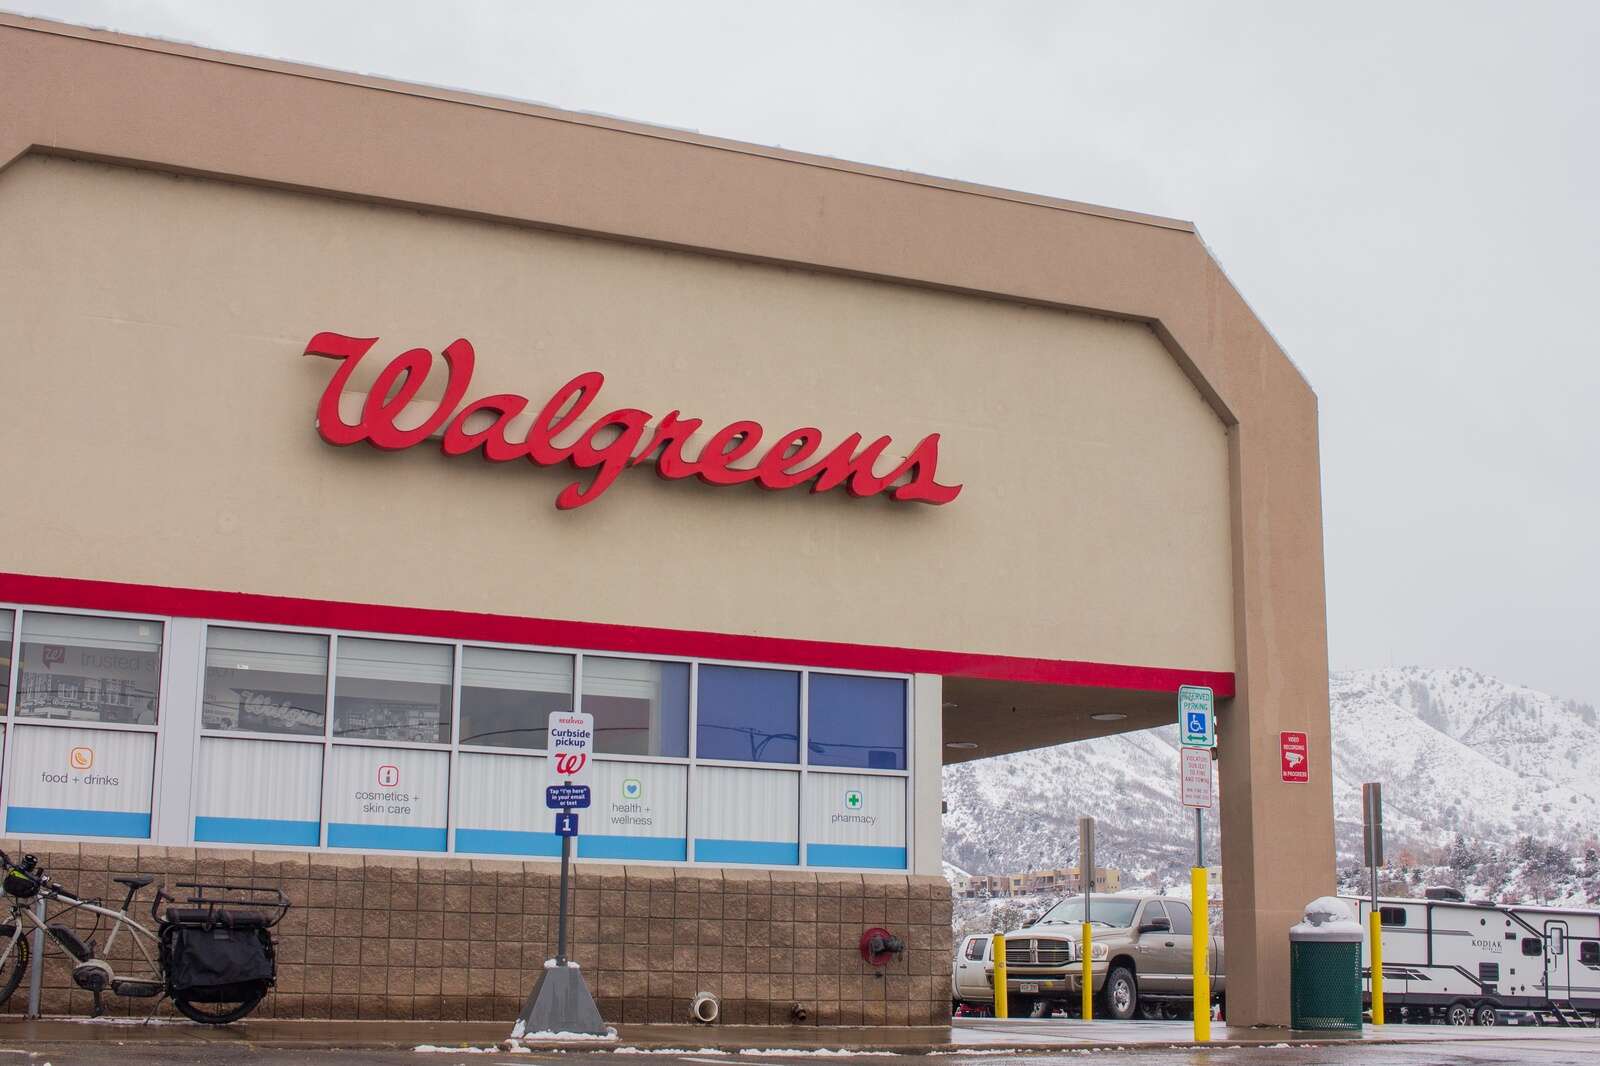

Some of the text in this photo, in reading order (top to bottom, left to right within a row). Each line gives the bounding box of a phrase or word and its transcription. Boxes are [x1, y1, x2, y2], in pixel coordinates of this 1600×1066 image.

[304, 330, 963, 510] Walgreens
[552, 729, 591, 739] Curbside
[555, 738, 586, 749] pickup
[41, 771, 69, 784] food
[84, 773, 119, 787] drinks
[355, 790, 410, 802] cosmetics
[363, 802, 412, 815] skin care
[612, 803, 642, 814] health
[562, 818, 571, 832] 1
[611, 814, 653, 826] wellness
[831, 813, 877, 825] pharmacy
[1472, 939, 1502, 948] KODIAK
